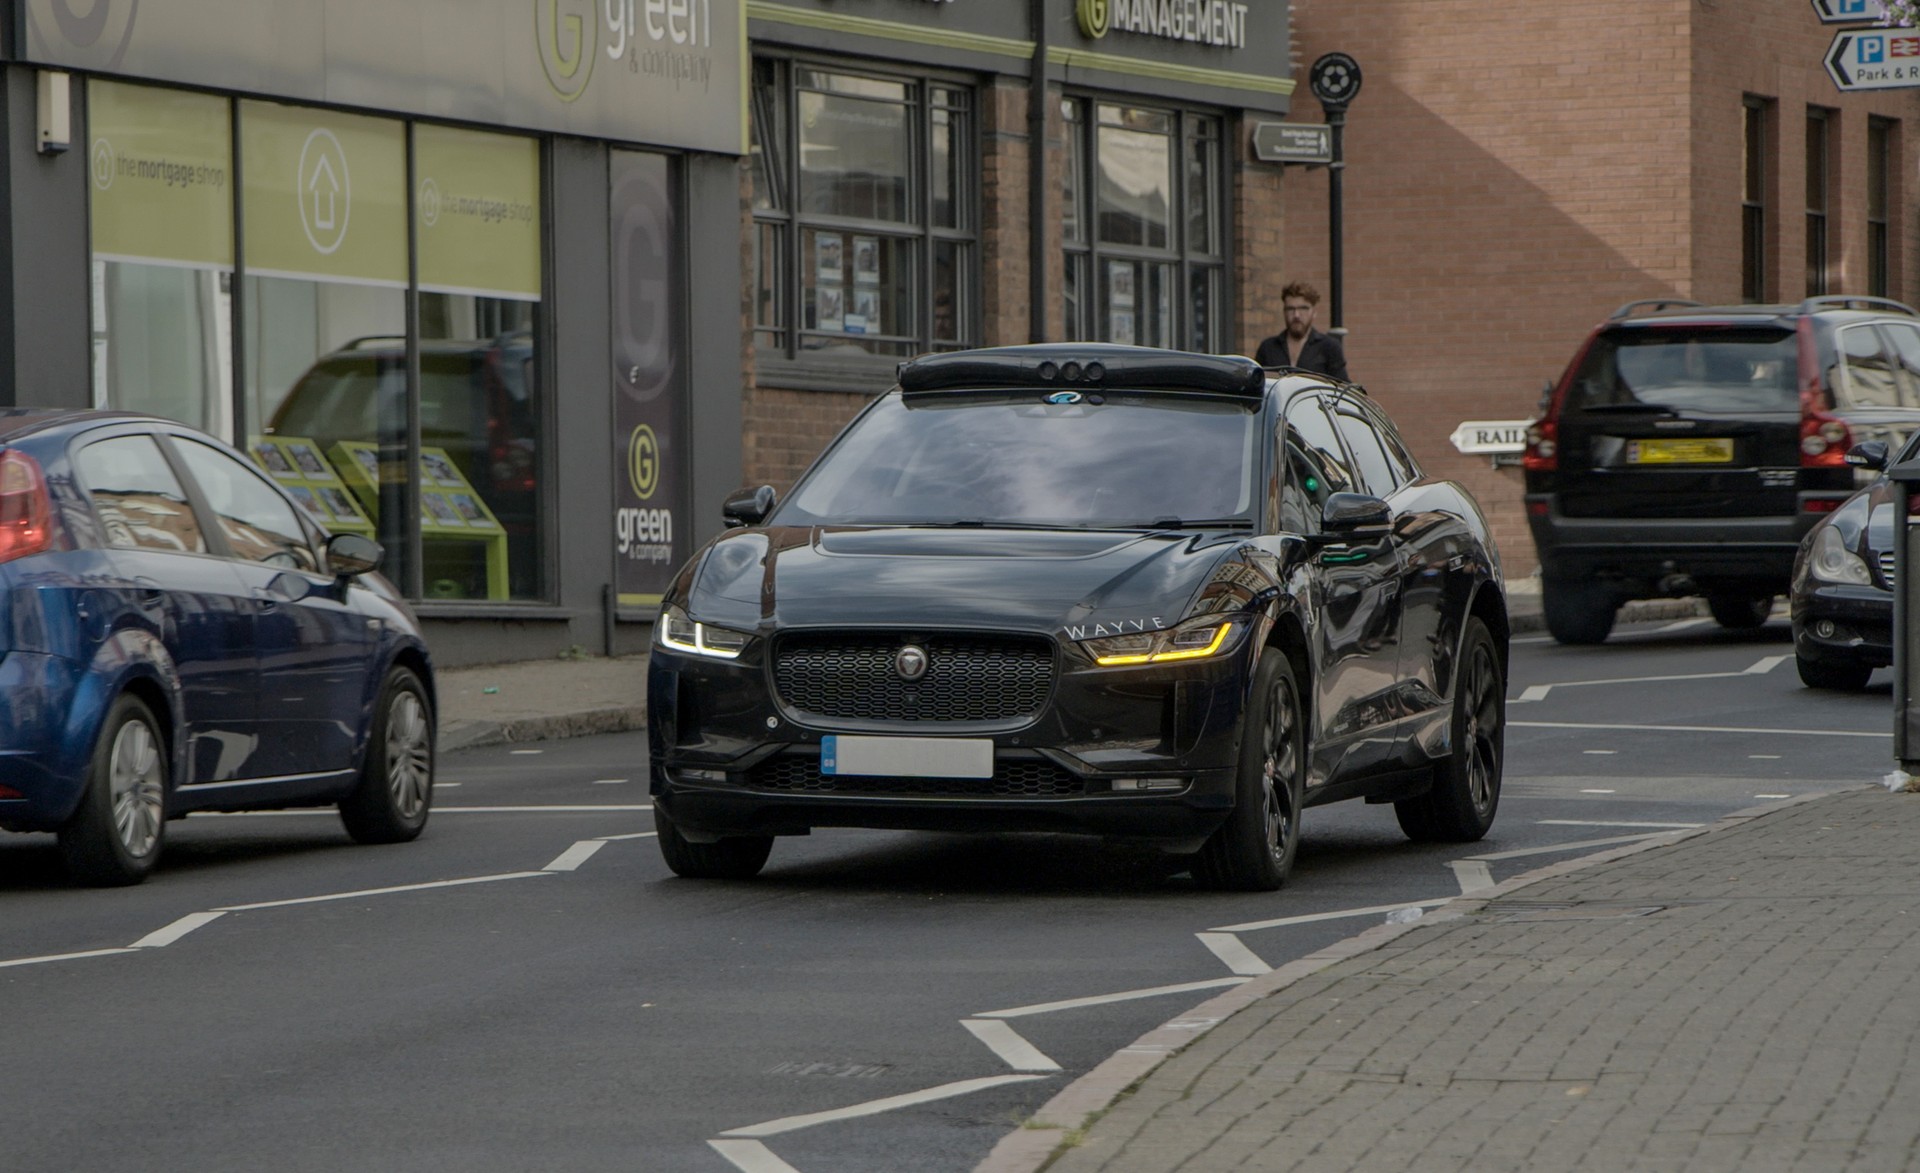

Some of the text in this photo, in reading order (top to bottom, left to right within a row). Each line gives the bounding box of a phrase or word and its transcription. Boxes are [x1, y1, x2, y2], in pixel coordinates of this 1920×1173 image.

[1113, 0, 1248, 48] MANAGEMENT
[642, 49, 711, 94] company
[1857, 67, 1889, 80] Park
[1894, 67, 1904, 79] &
[117, 151, 224, 192] the mortgage shop
[459, 197, 507, 223] mortgage
[1476, 429, 1528, 444] RAIL
[635, 435, 652, 490] G
[617, 508, 672, 554] green
[636, 544, 672, 565] company
[1064, 617, 1165, 639] WAYVE
